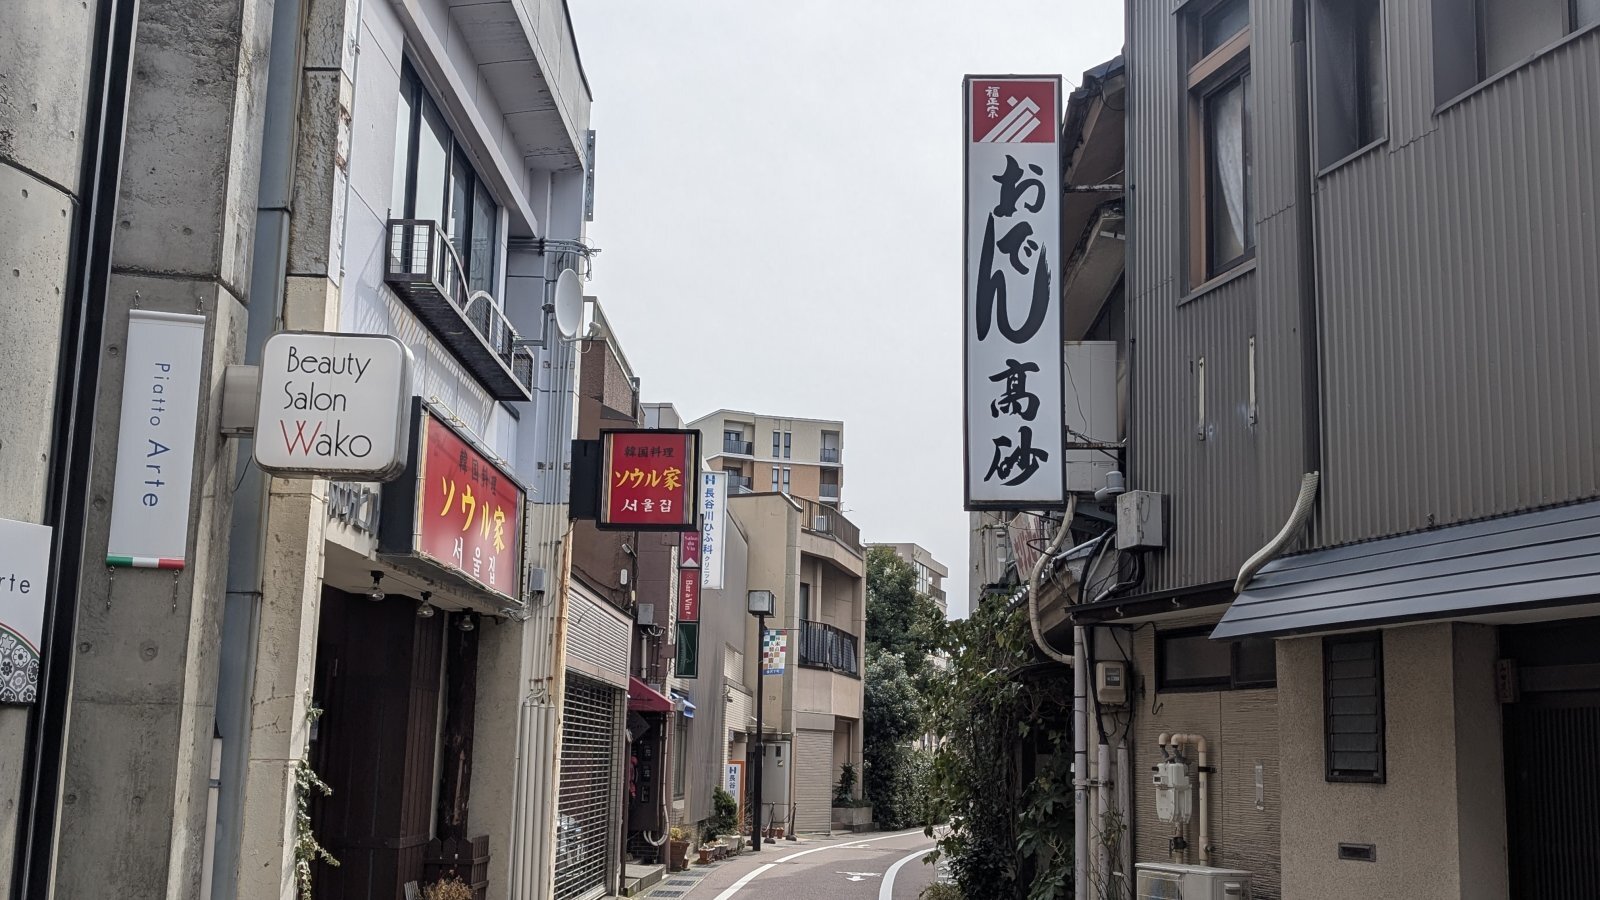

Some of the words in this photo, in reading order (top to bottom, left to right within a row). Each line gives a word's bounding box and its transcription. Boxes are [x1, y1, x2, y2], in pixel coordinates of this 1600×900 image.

[985, 86, 1001, 119] 福正宗
[976, 154, 1051, 344] おでん
[287, 346, 372, 383] Beauty
[150, 362, 171, 426] Piatto
[283, 381, 346, 412] Salon
[279, 419, 372, 458] Wako
[983, 358, 1049, 487] 高砂
[142, 439, 171, 507] Arte
[459, 449, 497, 496] 韓国料理
[624, 446, 674, 458] 韓国料理
[615, 466, 682, 491] ソウル家
[440, 476, 506, 555] ソウル家
